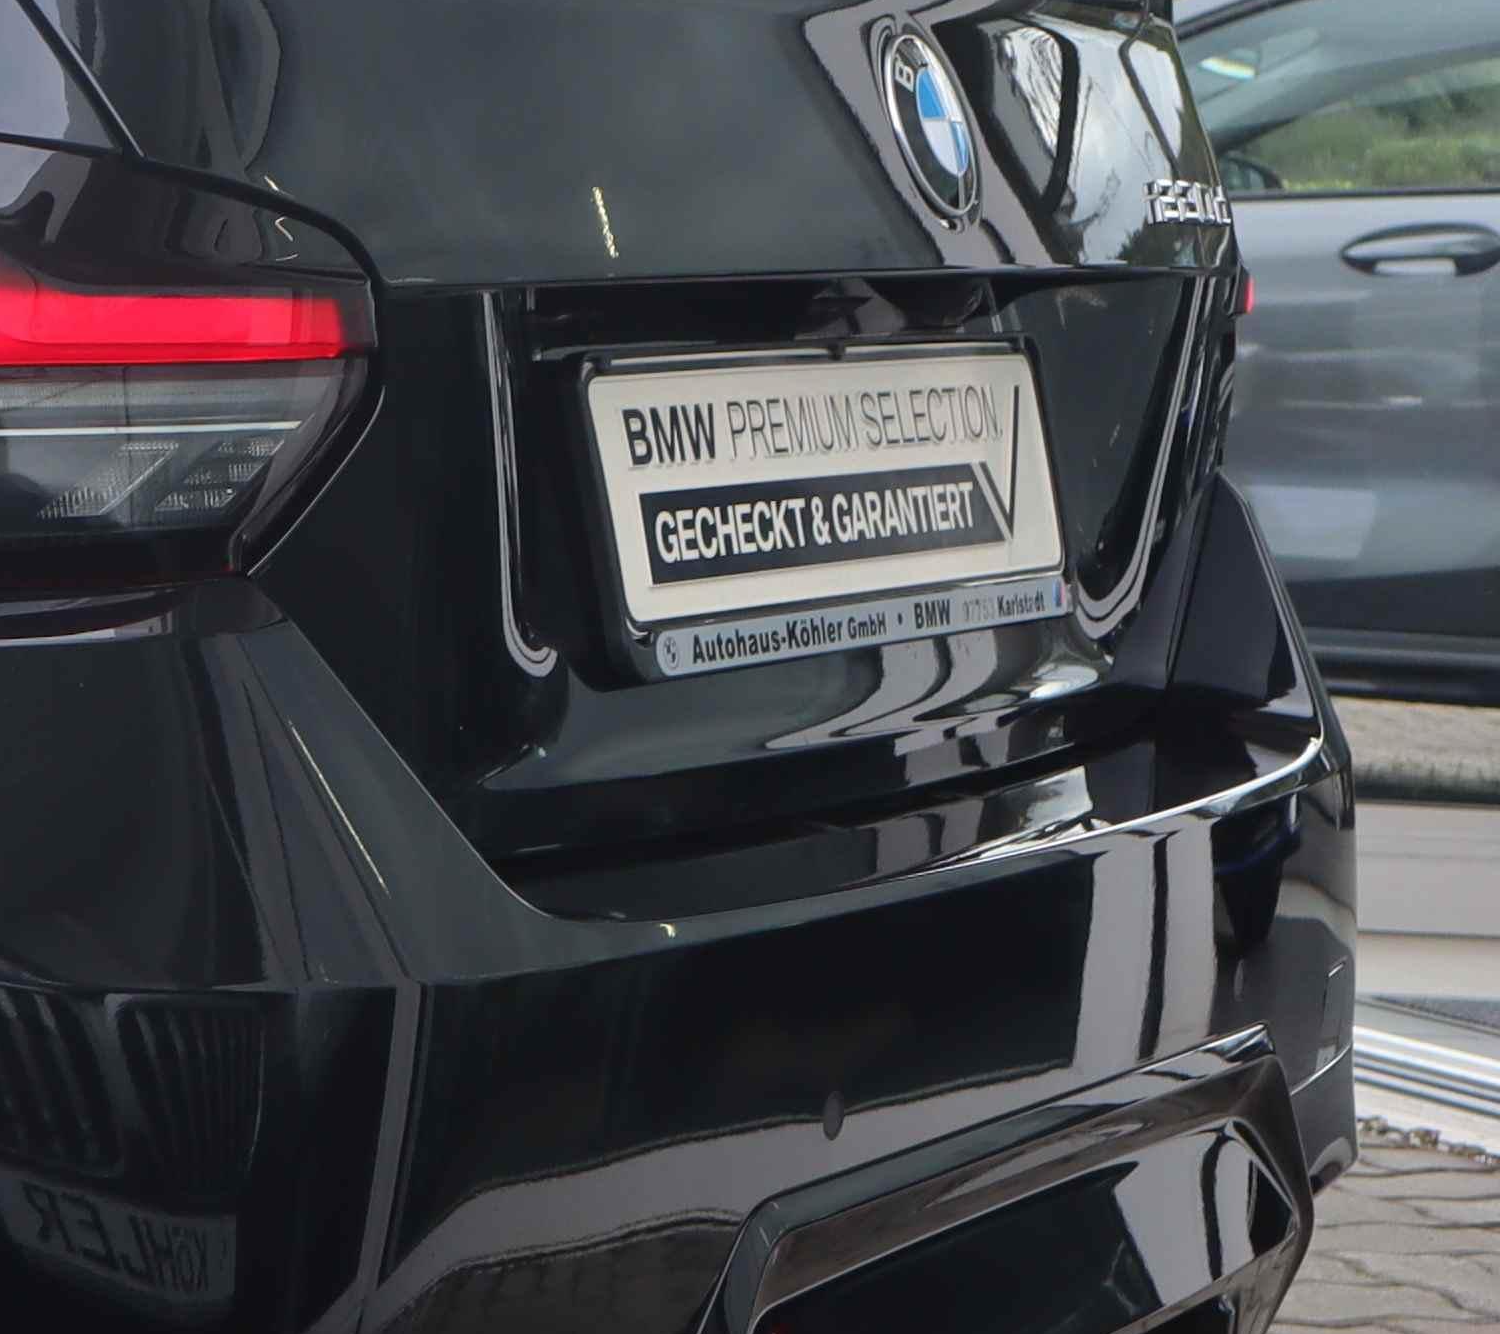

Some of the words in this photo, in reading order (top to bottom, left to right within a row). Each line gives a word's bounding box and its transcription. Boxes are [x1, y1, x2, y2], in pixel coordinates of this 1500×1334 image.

[622, 402, 716, 466] BMW
[726, 394, 858, 460] PREMIUM
[655, 497, 806, 564] GECHECKT
[810, 496, 832, 546] &
[832, 481, 974, 544] GARANTIERT
[692, 615, 843, 665] Autohaus-Köhler
[847, 611, 887, 640] GmbH
[913, 598, 950, 629] BMW
